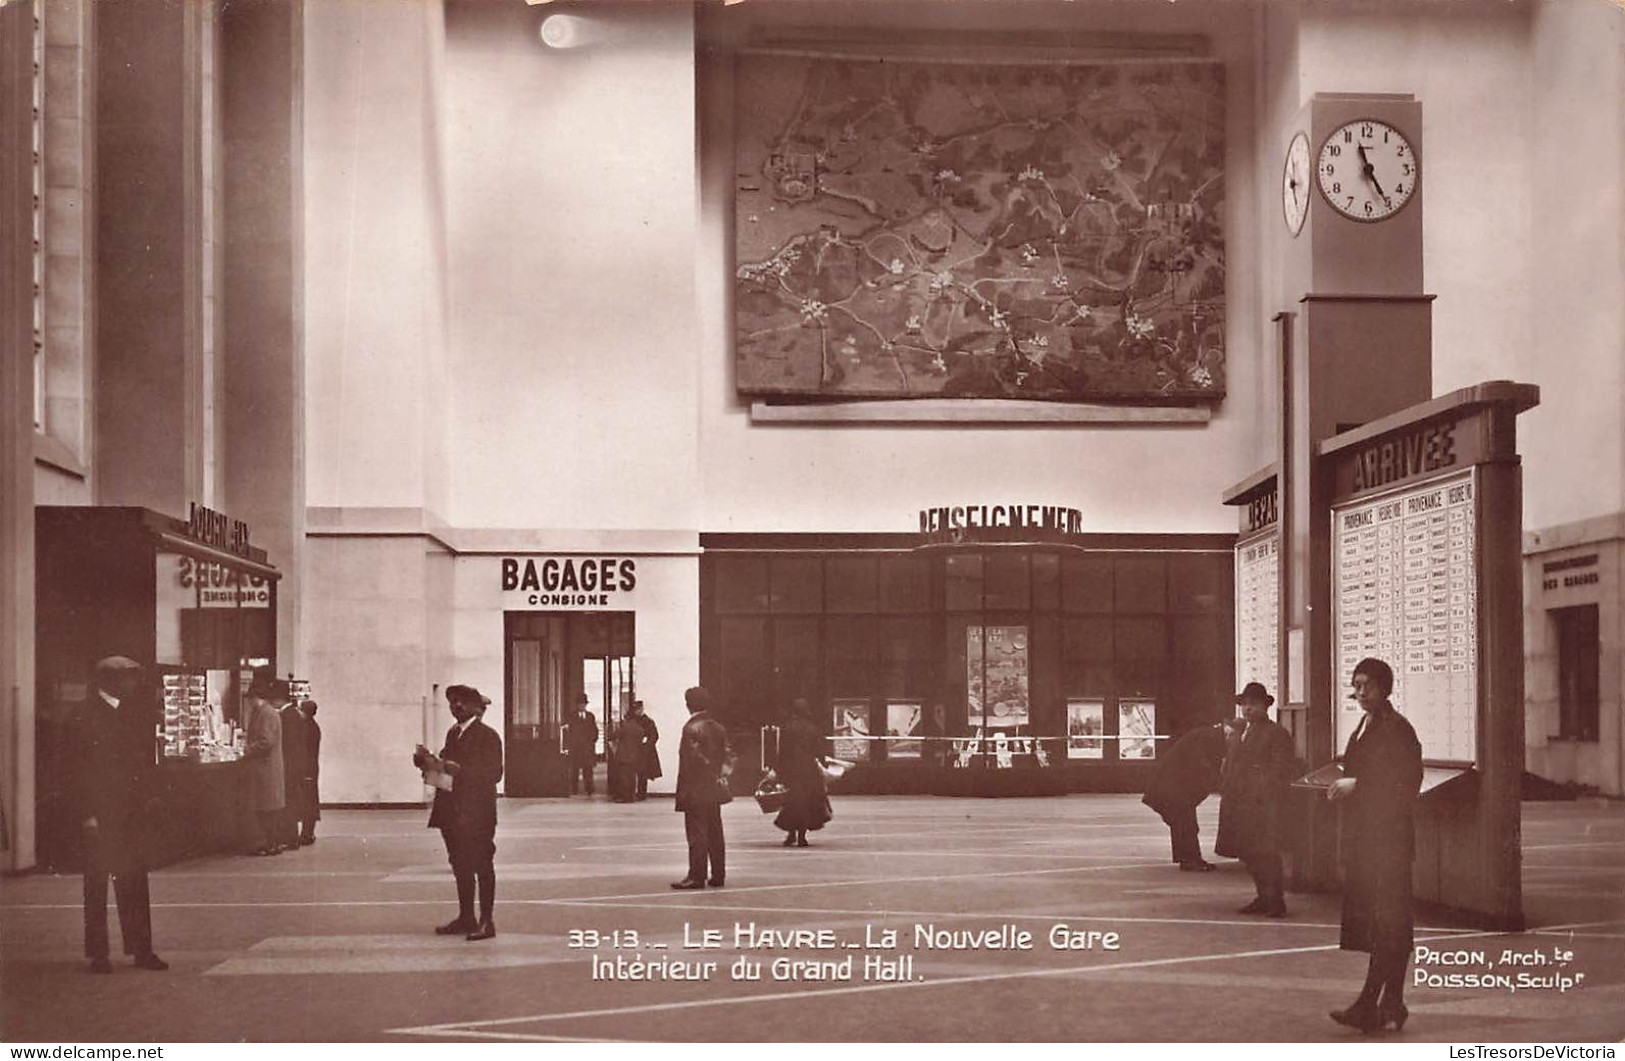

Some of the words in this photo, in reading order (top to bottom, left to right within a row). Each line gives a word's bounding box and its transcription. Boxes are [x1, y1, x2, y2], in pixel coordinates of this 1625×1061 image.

[1344, 131, 1352, 143] 11
[1361, 126, 1373, 138] 12
[1383, 132, 1389, 144] 1
[1329, 145, 1341, 156] 10
[1397, 145, 1404, 157] 2
[1326, 164, 1334, 176] 9
[1403, 164, 1410, 176] 3
[1333, 183, 1341, 194] 8
[1395, 183, 1403, 194] 4
[1347, 196, 1354, 208] 7
[1364, 201, 1373, 213] 6
[502, 558, 636, 591] BAGAGES
[528, 595, 608, 605] CONSIGNE
